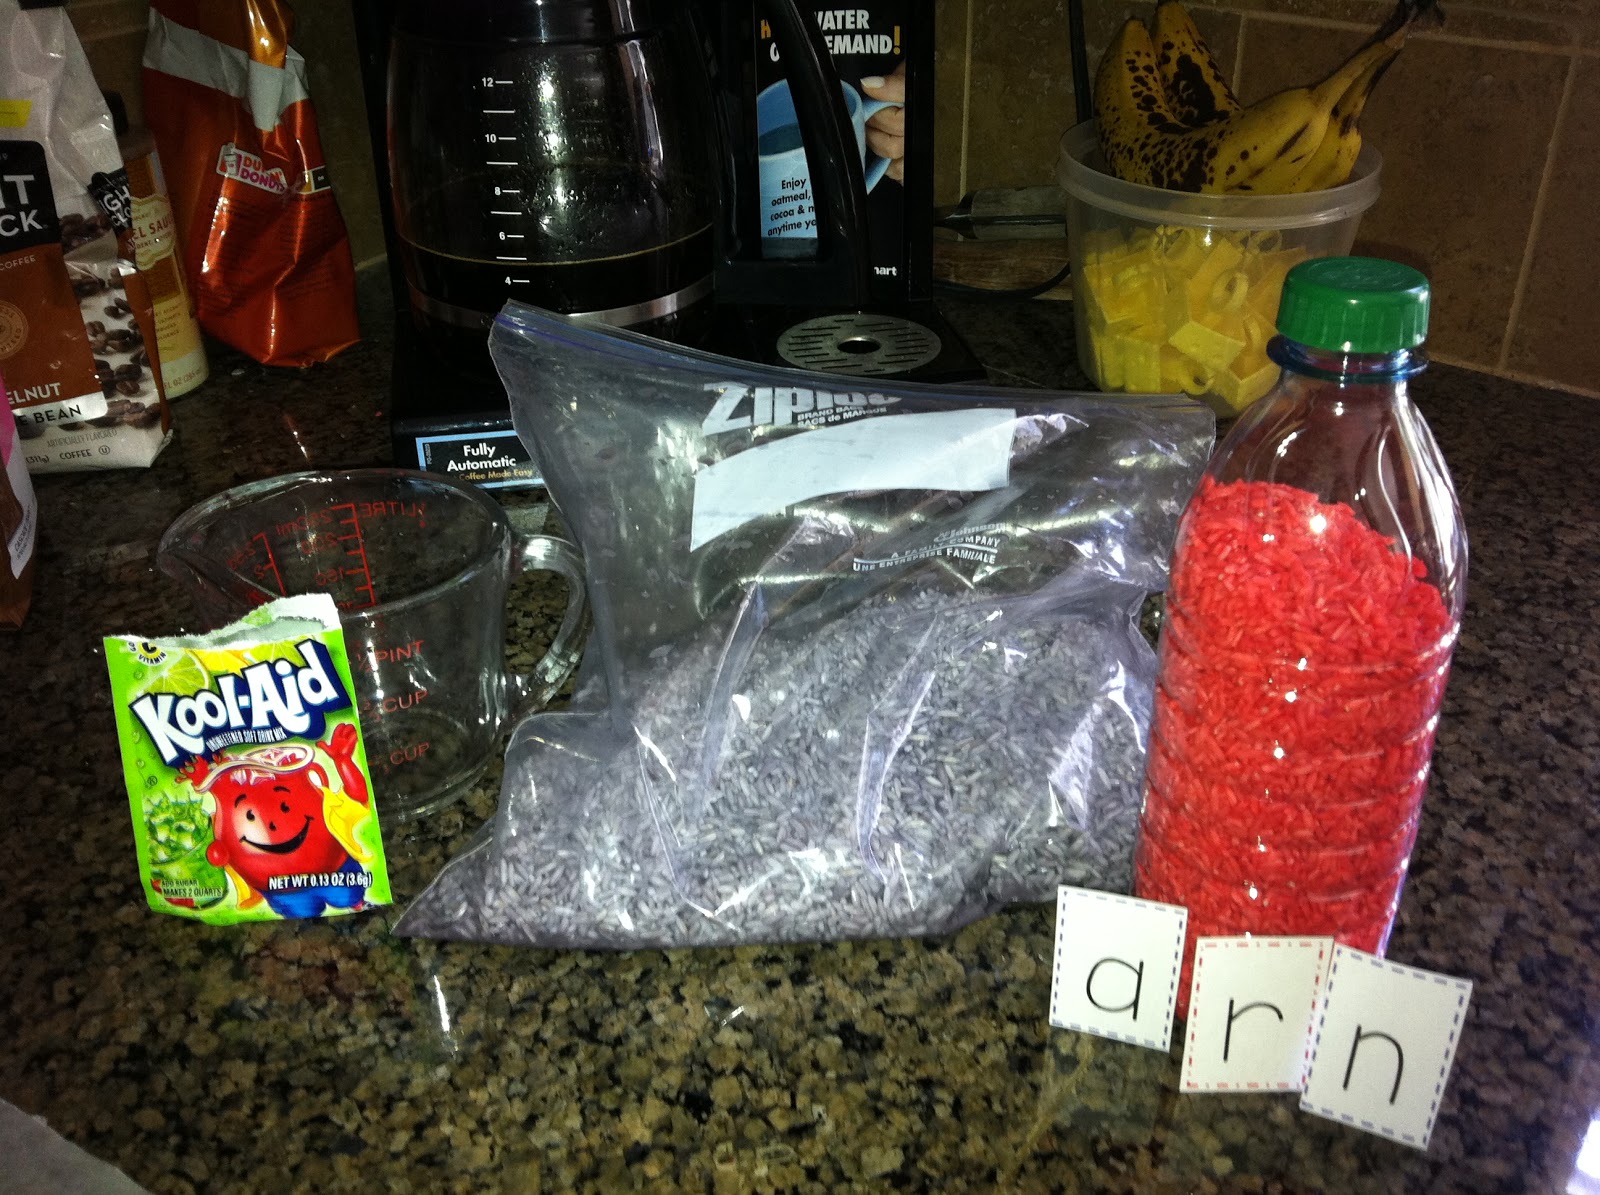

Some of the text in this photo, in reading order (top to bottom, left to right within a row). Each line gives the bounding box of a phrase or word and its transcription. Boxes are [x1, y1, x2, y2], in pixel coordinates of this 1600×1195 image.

[482, 77, 494, 87] 12
[485, 134, 497, 143] 10
[494, 187, 501, 196] 8
[781, 177, 807, 191] Enjoy
[771, 189, 812, 207] oatmeal,
[770, 208, 795, 221] cocoa
[797, 204, 805, 215] &
[499, 232, 506, 241] 6
[767, 220, 803, 237] anytime
[504, 276, 512, 286] 4
[33, 404, 83, 425] BEAN
[797, 408, 834, 421] BRAND
[828, 413, 842, 423] de
[85, 428, 118, 442] FLAVORED
[59, 448, 93, 461] COFFEE
[463, 442, 497, 459] Fully
[446, 455, 517, 472] Automatic
[458, 467, 534, 482] Coffee Made Easy
[138, 651, 167, 665] VITAMIN
[375, 639, 425, 663] PINT
[131, 638, 341, 765] Kool-Aid
[382, 689, 429, 713] CUP
[205, 726, 288, 752] UNSWEETENED SOFT DRINK MIX
[390, 741, 431, 765] CUP
[268, 871, 373, 890] NET WT 0.13 OZ (3.6g)
[163, 887, 223, 897] MAKES 2 QUARTS
[1086, 956, 1144, 1021] a
[1222, 997, 1284, 1063] r
[1342, 1024, 1405, 1106] n
